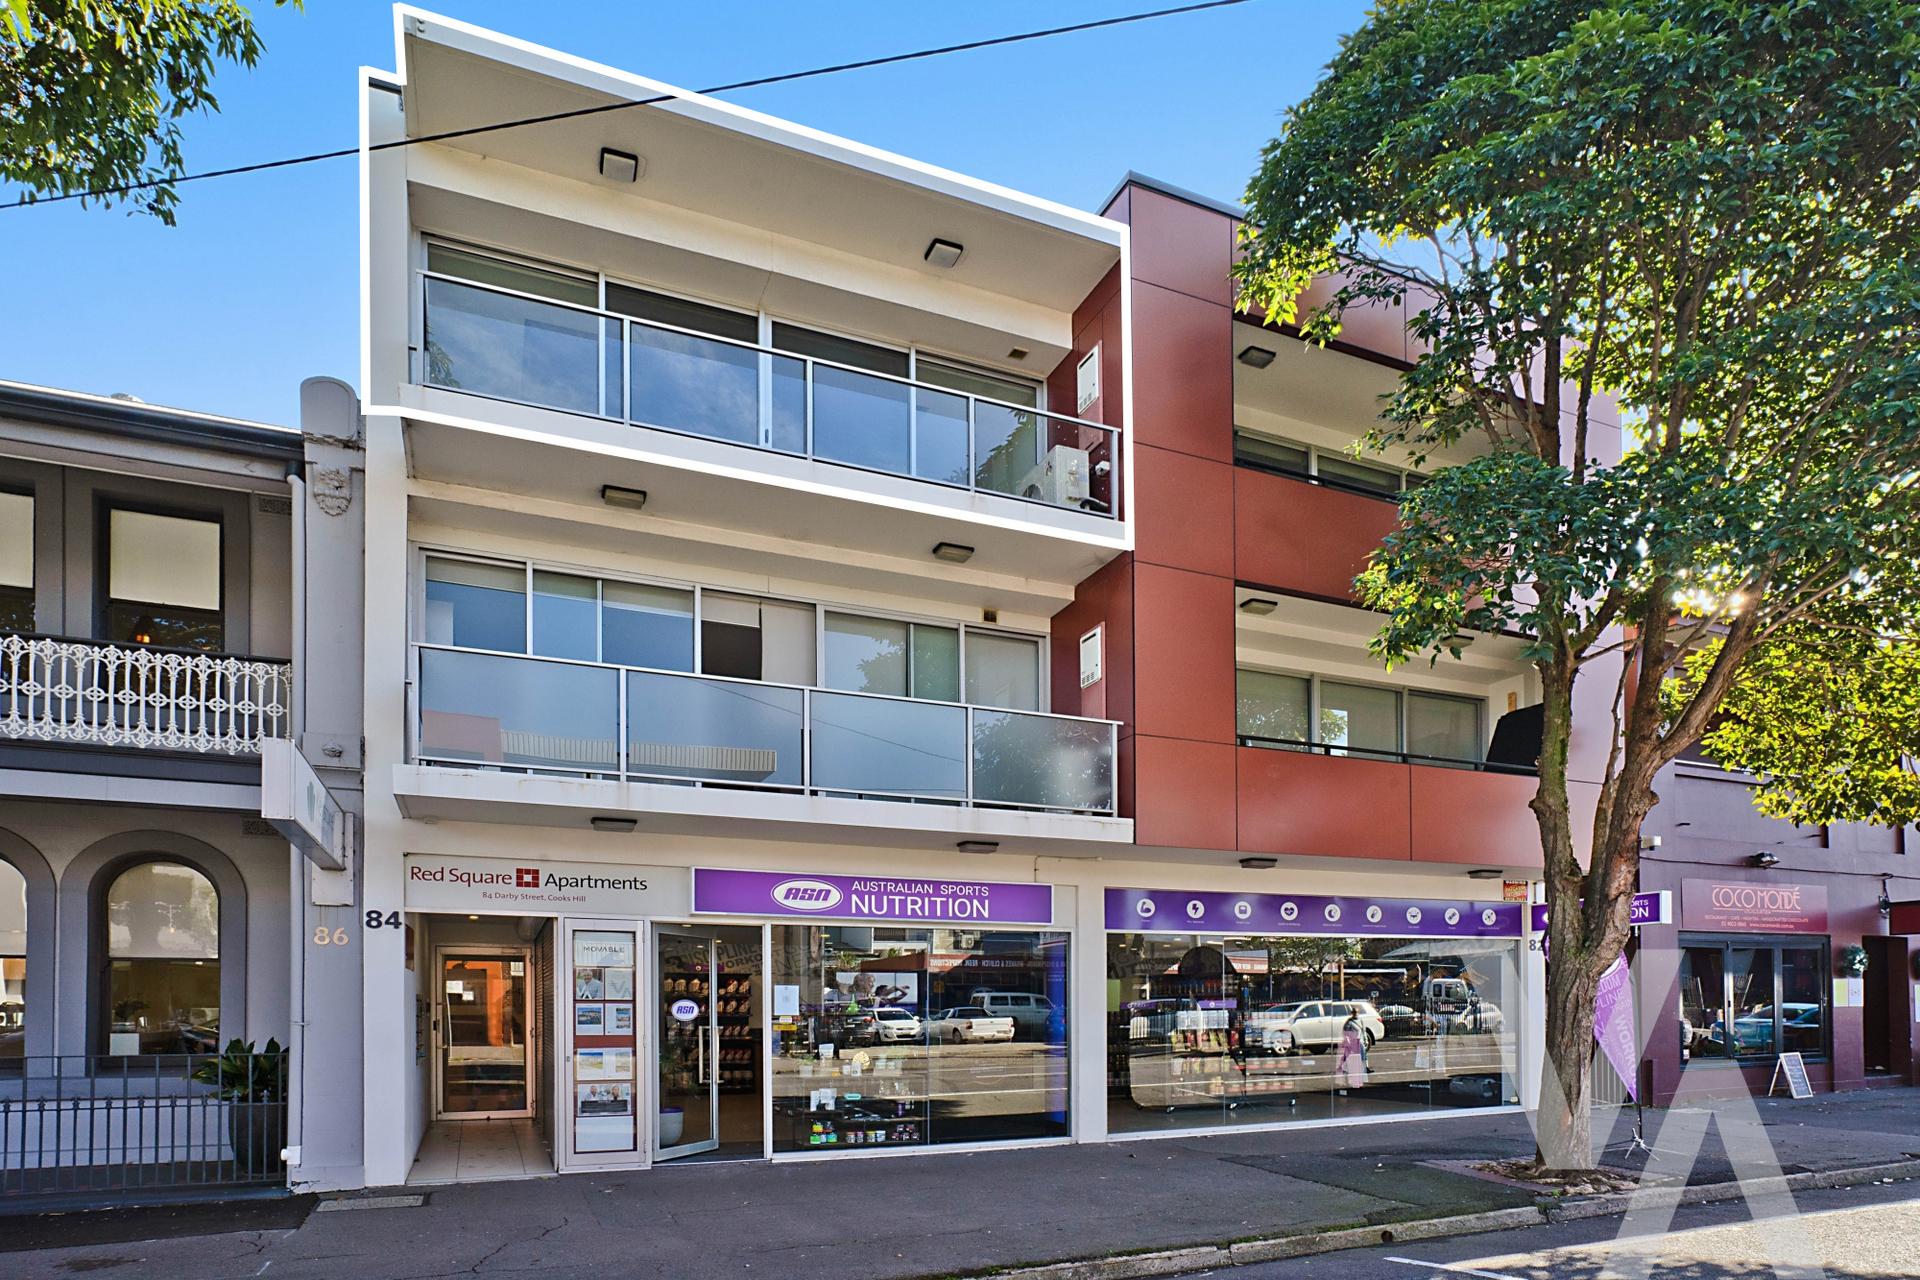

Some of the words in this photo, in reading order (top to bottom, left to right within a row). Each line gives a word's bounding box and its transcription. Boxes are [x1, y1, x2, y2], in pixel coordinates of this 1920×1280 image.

[410, 866, 445, 882] Red
[449, 867, 513, 887] Square
[544, 872, 648, 892] Apartments
[852, 880, 933, 894] AUSTRALIAN
[940, 884, 989, 897] SPORTS
[482, 891, 493, 900] 84
[494, 892, 518, 901] Darby
[520, 893, 546, 902] Street,
[548, 894, 570, 902] Cooks
[572, 894, 586, 903] Hill
[782, 887, 832, 902] ASN
[1711, 888, 1756, 908] COCO
[851, 893, 990, 919] NUTRITION
[365, 910, 402, 929] 84
[313, 926, 349, 945] 86
[676, 1005, 694, 1014] ASN
